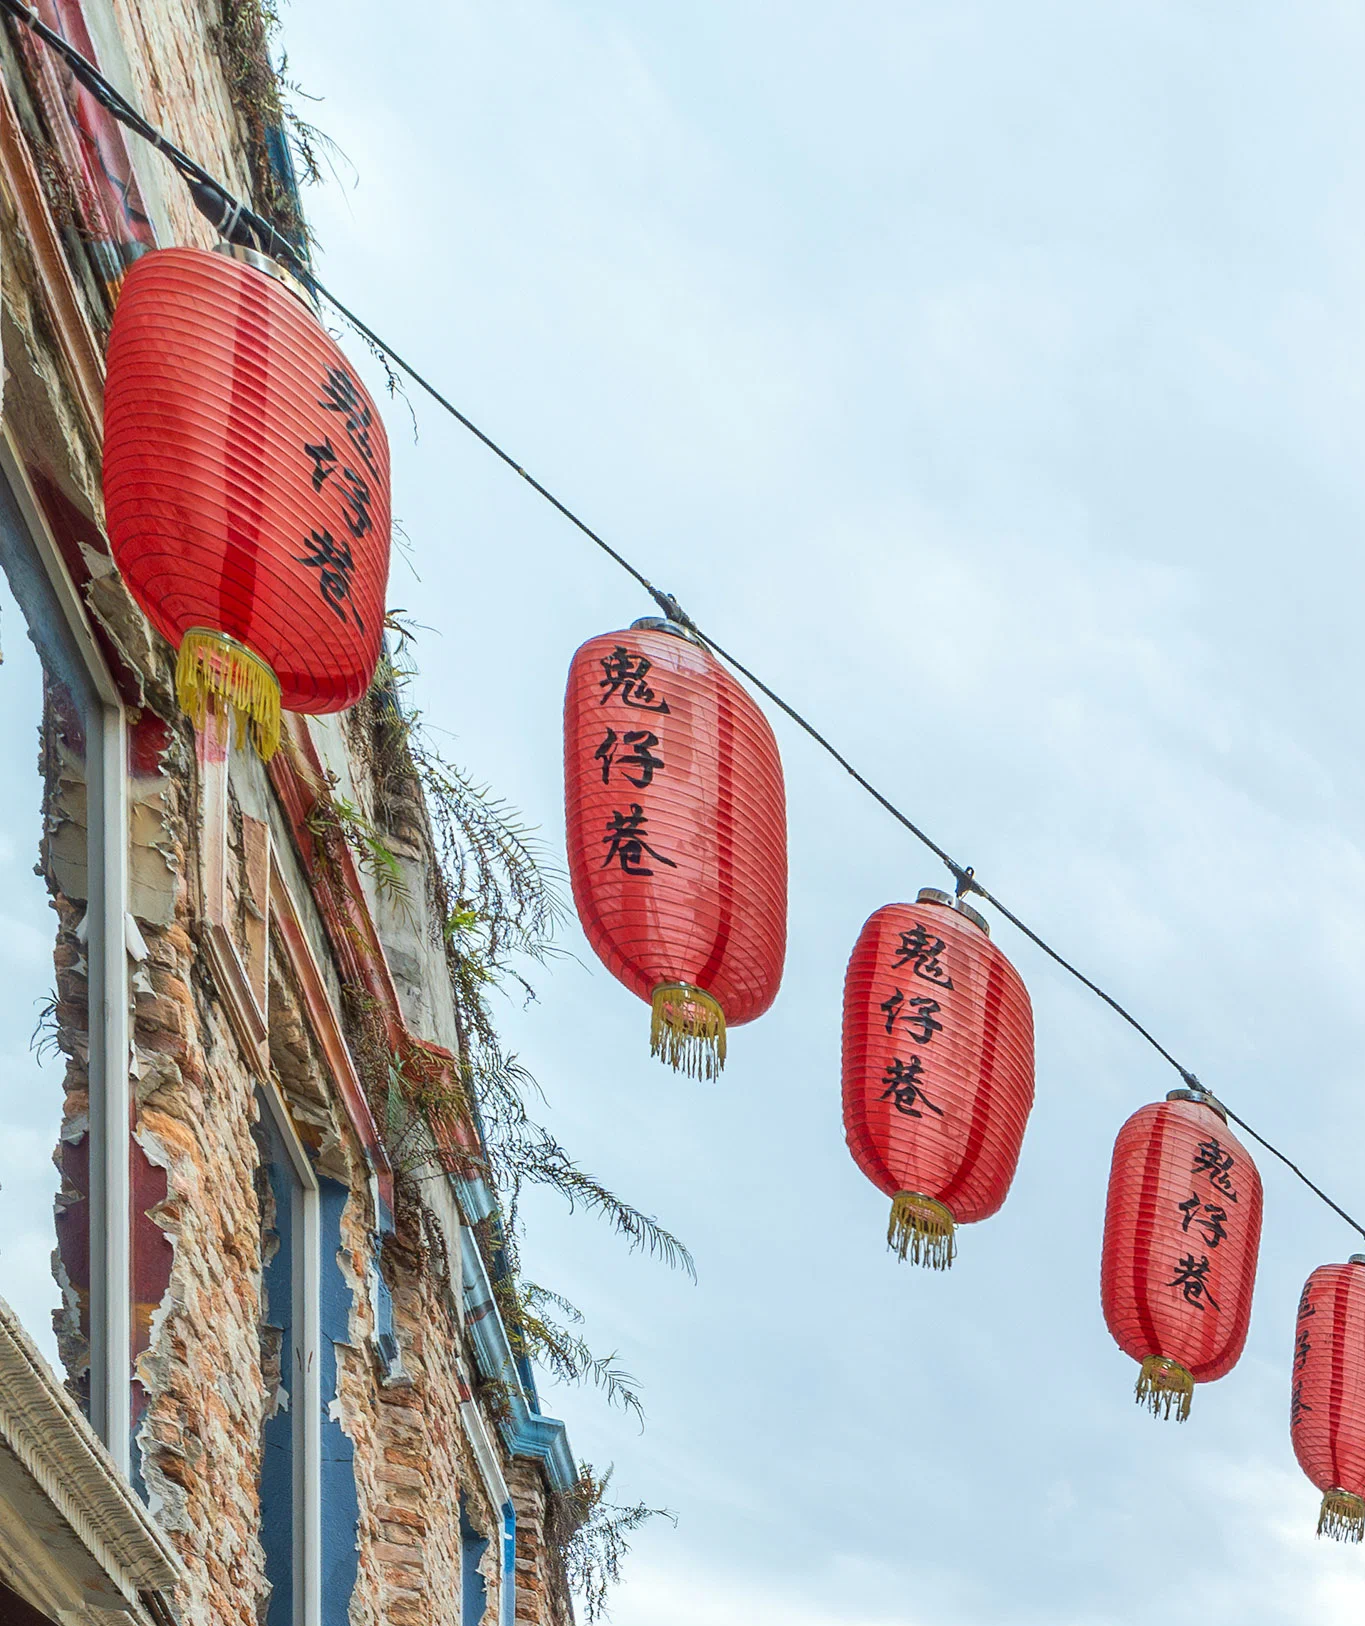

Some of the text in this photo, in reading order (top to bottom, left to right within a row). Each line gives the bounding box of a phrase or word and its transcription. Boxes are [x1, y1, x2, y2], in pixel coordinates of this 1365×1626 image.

[592, 645, 678, 877] 鬼仔巷
[877, 922, 954, 1120] 鬼仔巷
[1167, 1137, 1239, 1313] 鬼仔巷
